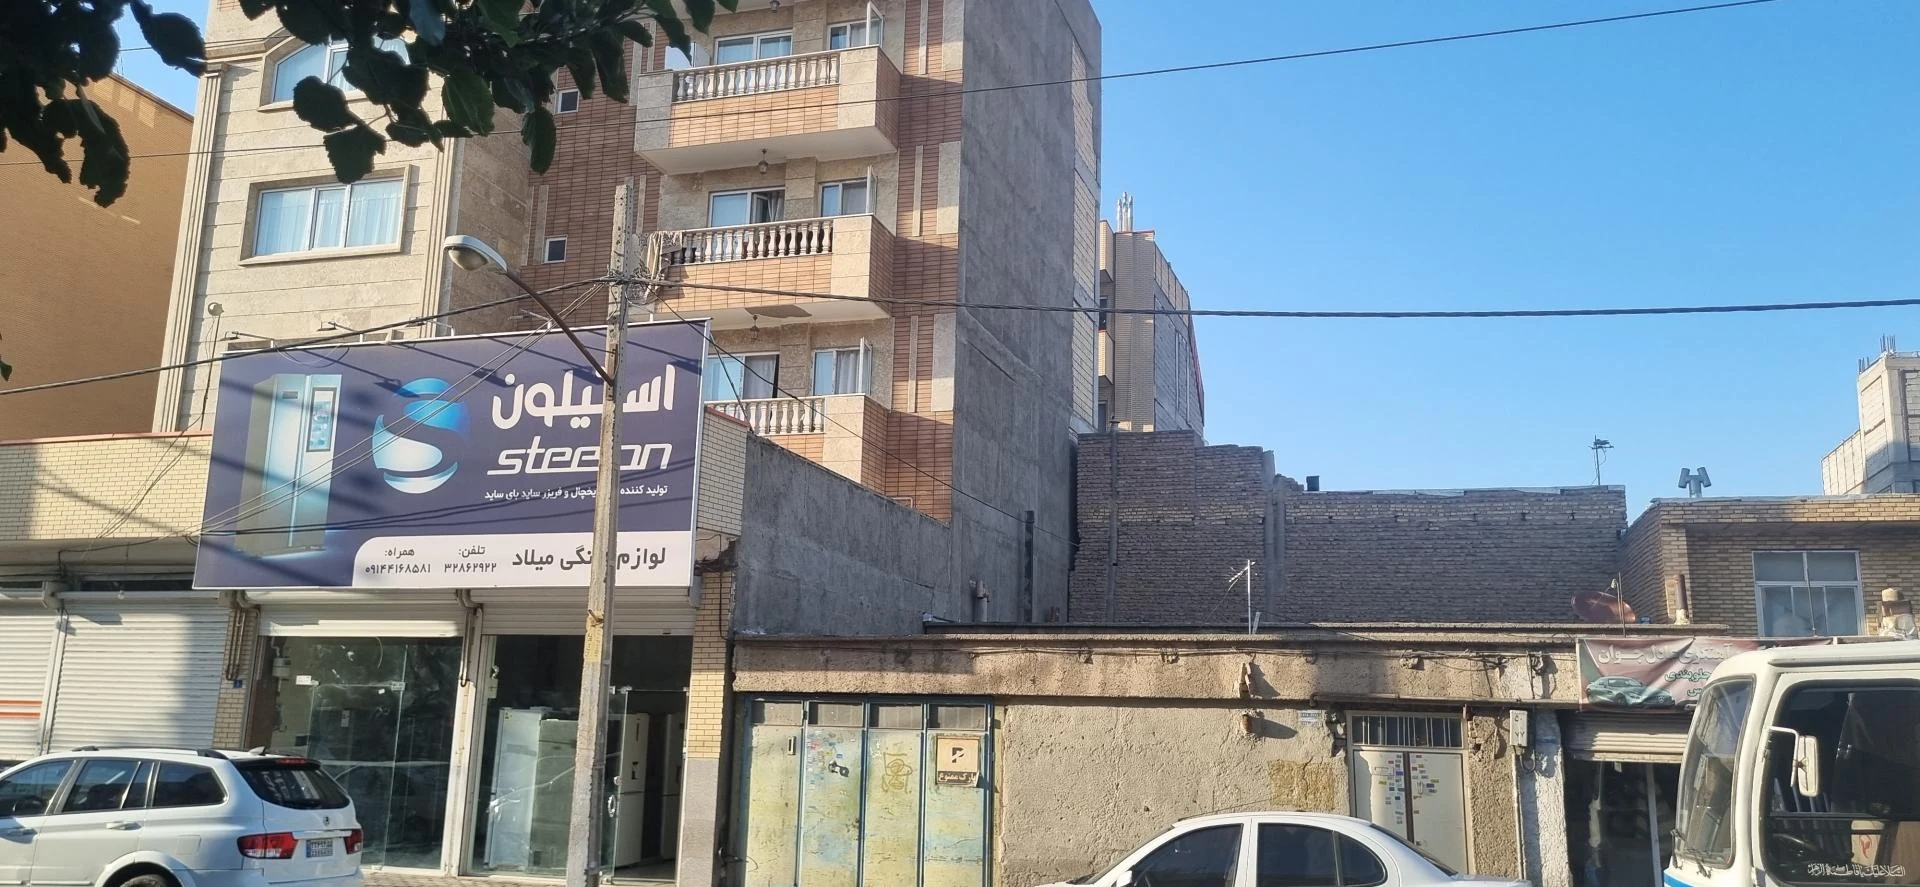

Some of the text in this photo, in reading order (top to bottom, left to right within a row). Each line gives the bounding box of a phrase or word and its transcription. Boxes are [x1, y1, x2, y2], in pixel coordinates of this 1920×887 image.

[491, 364, 675, 429] اسیلون
[487, 436, 673, 475] steeon
[484, 489, 504, 500] ساید
[505, 490, 519, 501] بای
[521, 489, 541, 501] ساید
[542, 488, 563, 499] فریزر
[564, 490, 569, 498] و
[619, 485, 644, 495] کننده
[646, 485, 668, 497] تولید
[384, 547, 415, 559] همراه:
[458, 545, 486, 558] تلفن:
[512, 549, 554, 571] میلاد
[617, 547, 666, 570] لوازم
[1598, 644, 1645, 664] جوان
